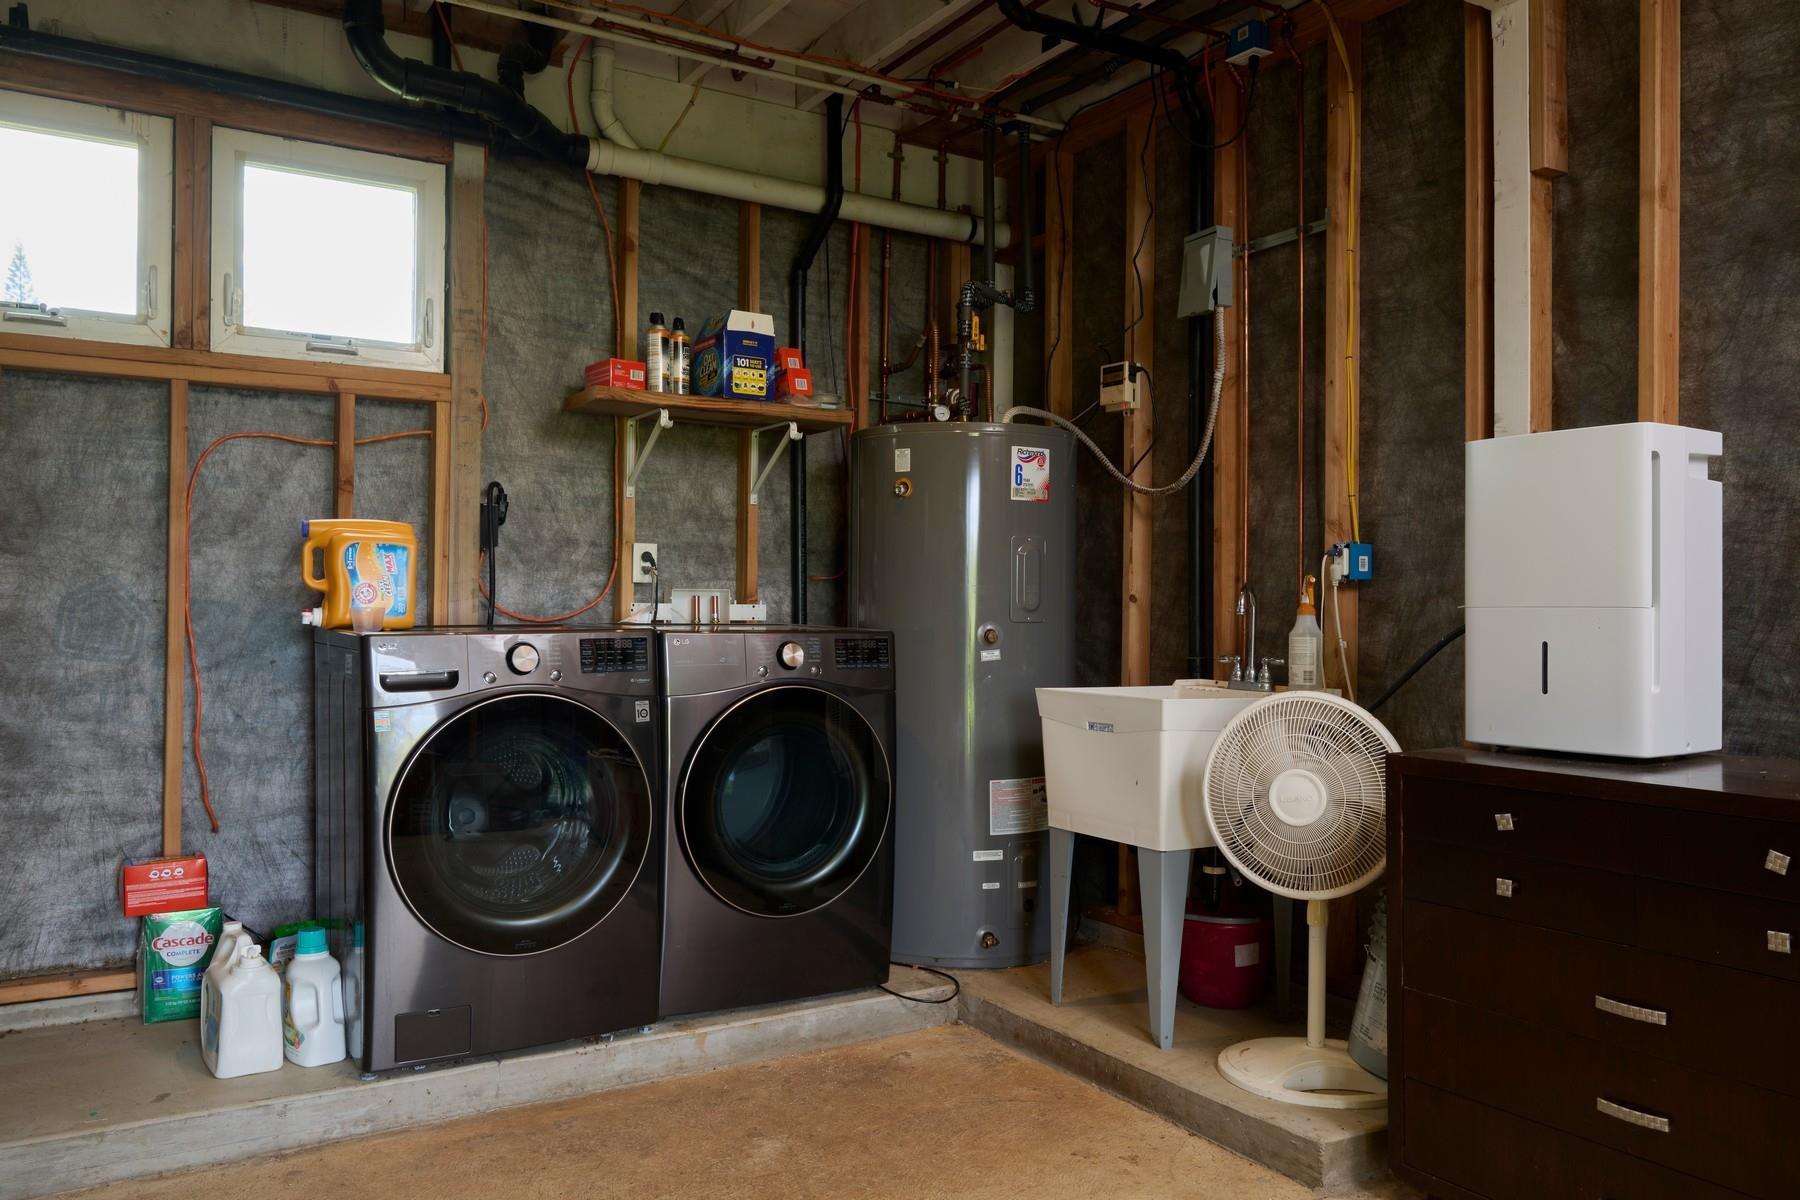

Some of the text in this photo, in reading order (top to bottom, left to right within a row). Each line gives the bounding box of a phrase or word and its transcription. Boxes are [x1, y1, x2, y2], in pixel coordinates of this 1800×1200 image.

[737, 357, 749, 367] 101
[1017, 448, 1046, 457] Richmond
[1015, 464, 1023, 486] 6
[383, 554, 395, 573] MAX
[153, 932, 214, 951] Cascade
[166, 949, 200, 957] COMPLETE
